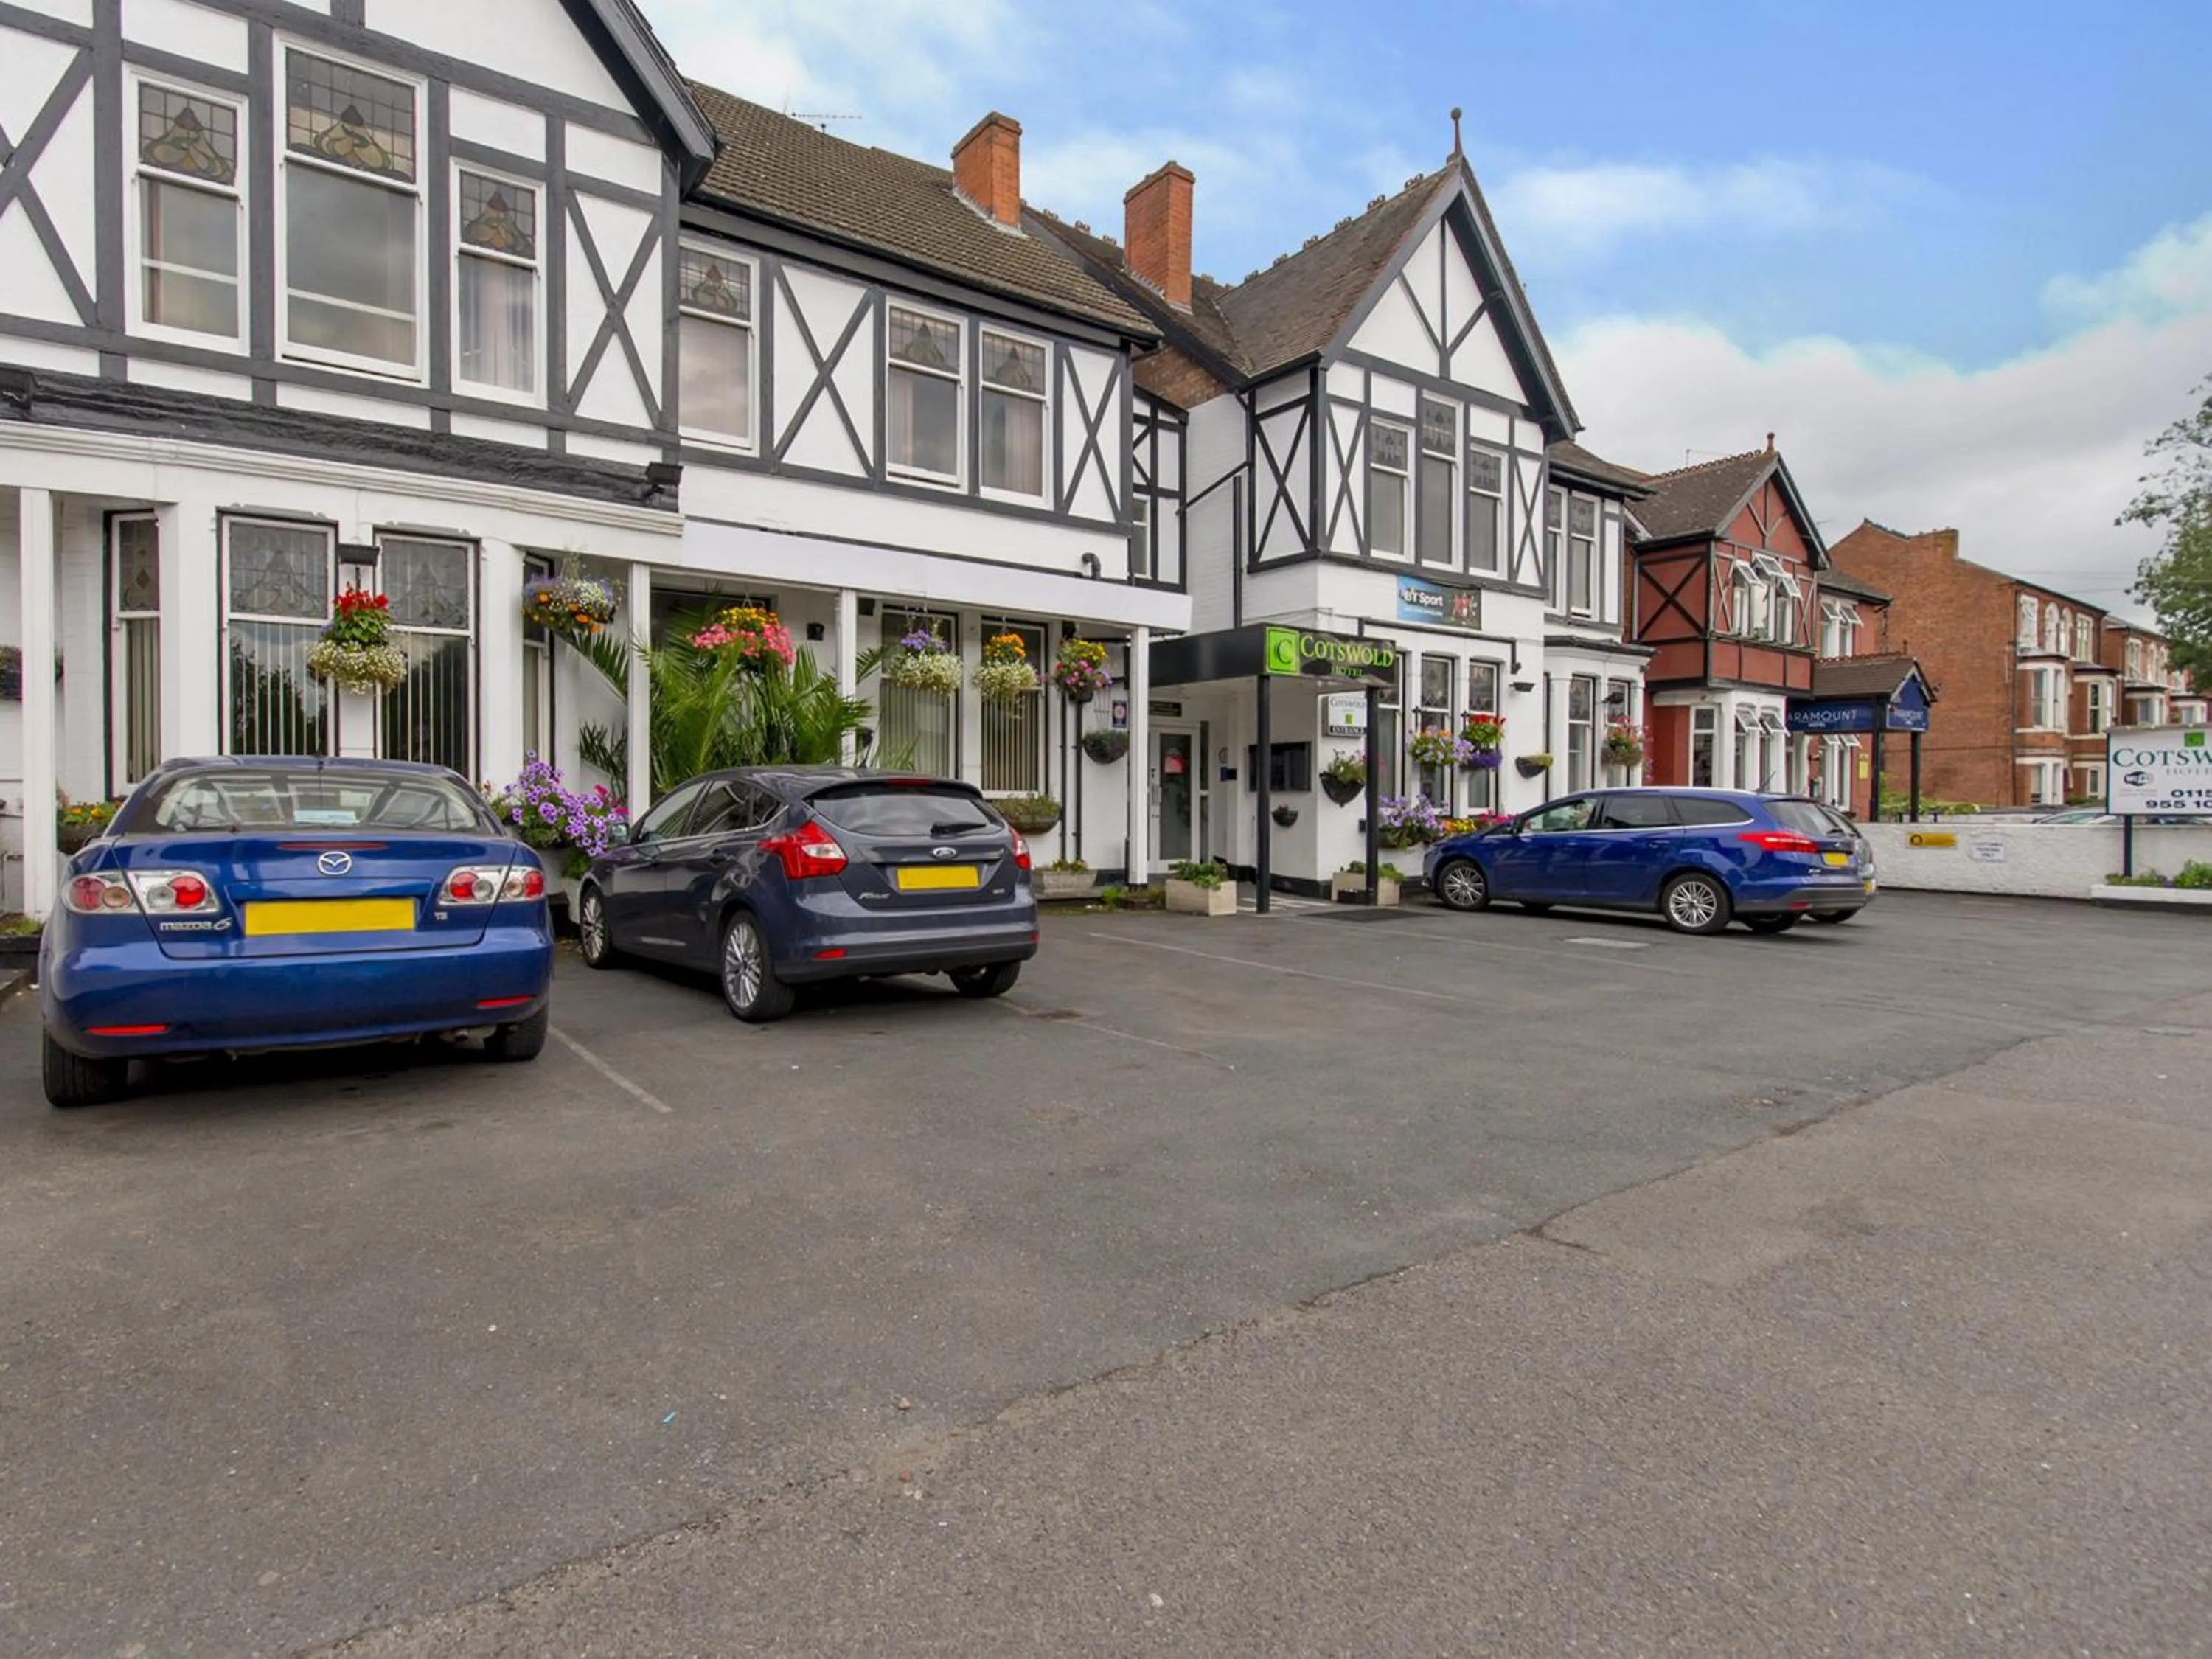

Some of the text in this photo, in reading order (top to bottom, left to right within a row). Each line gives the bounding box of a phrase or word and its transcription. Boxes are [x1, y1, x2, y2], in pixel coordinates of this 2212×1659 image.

[1419, 593, 1444, 606] Sport
[1300, 635, 1394, 667] COTSWOLD
[1331, 664, 1363, 677] HOTEL
[1787, 709, 1857, 722] ARAMOUNT
[2145, 800, 2185, 809] 955
